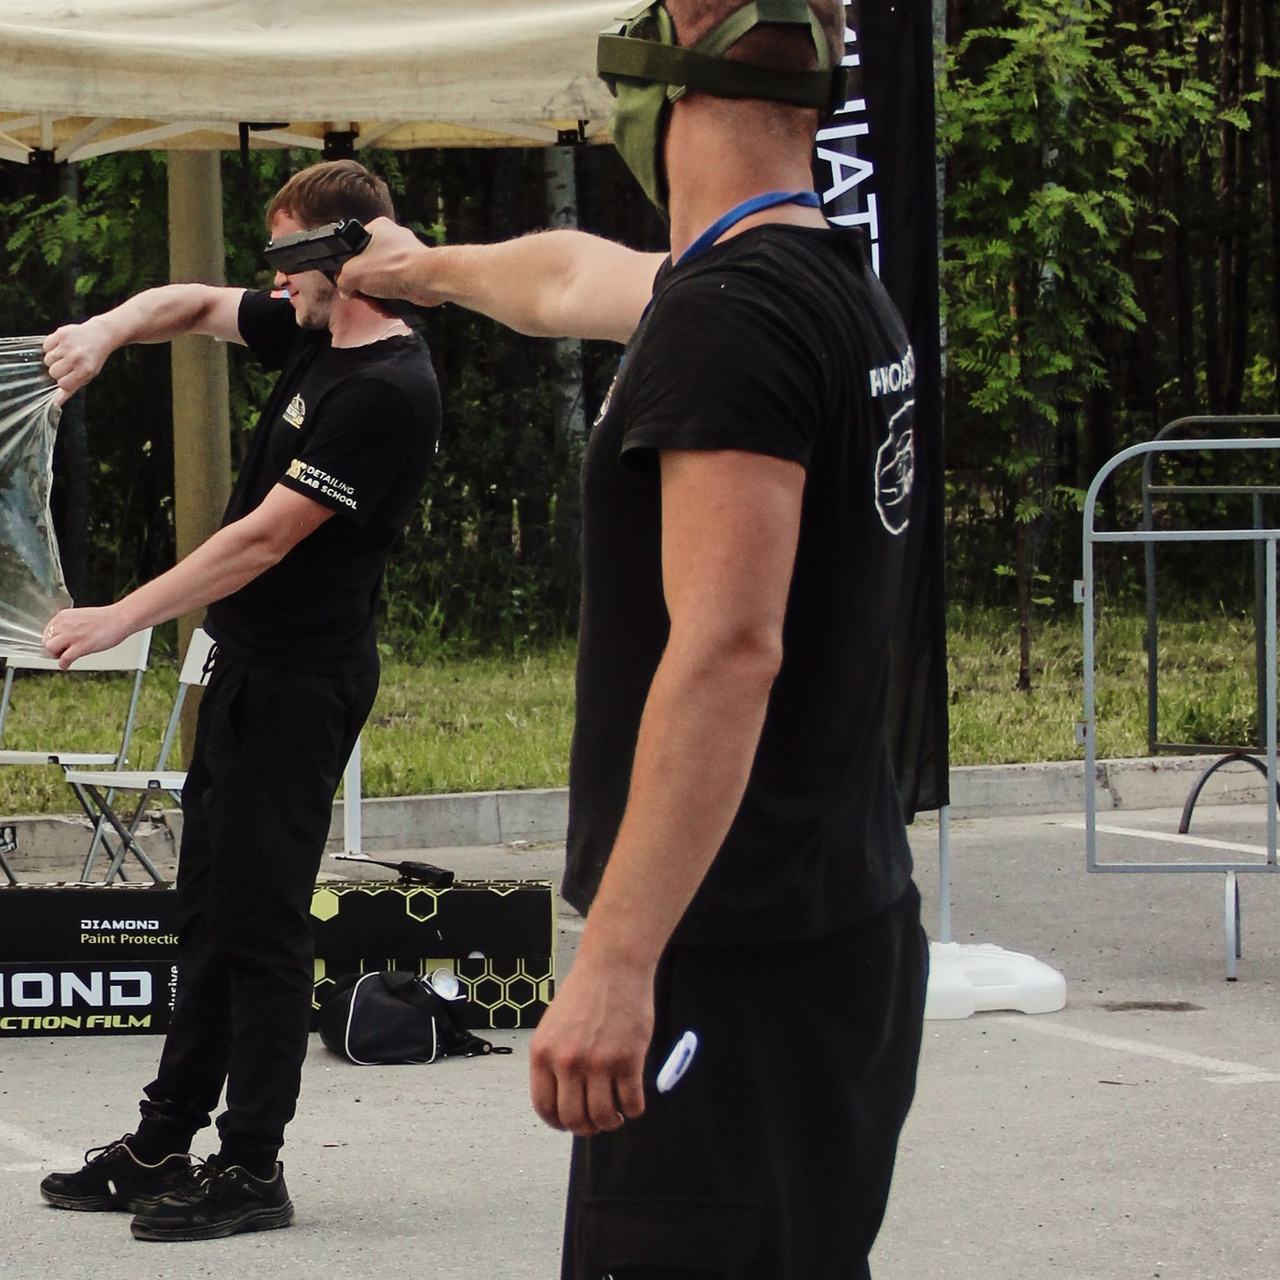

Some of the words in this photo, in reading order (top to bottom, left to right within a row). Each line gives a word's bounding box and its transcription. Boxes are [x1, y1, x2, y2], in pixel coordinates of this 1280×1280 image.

[307, 465, 355, 495] DETAILING
[300, 475, 320, 489] LAB
[320, 485, 357, 510] SCHOOL
[81, 920, 160, 930] DIAMOND
[81, 933, 116, 944] Paint
[86, 1014, 152, 1028] FILM
